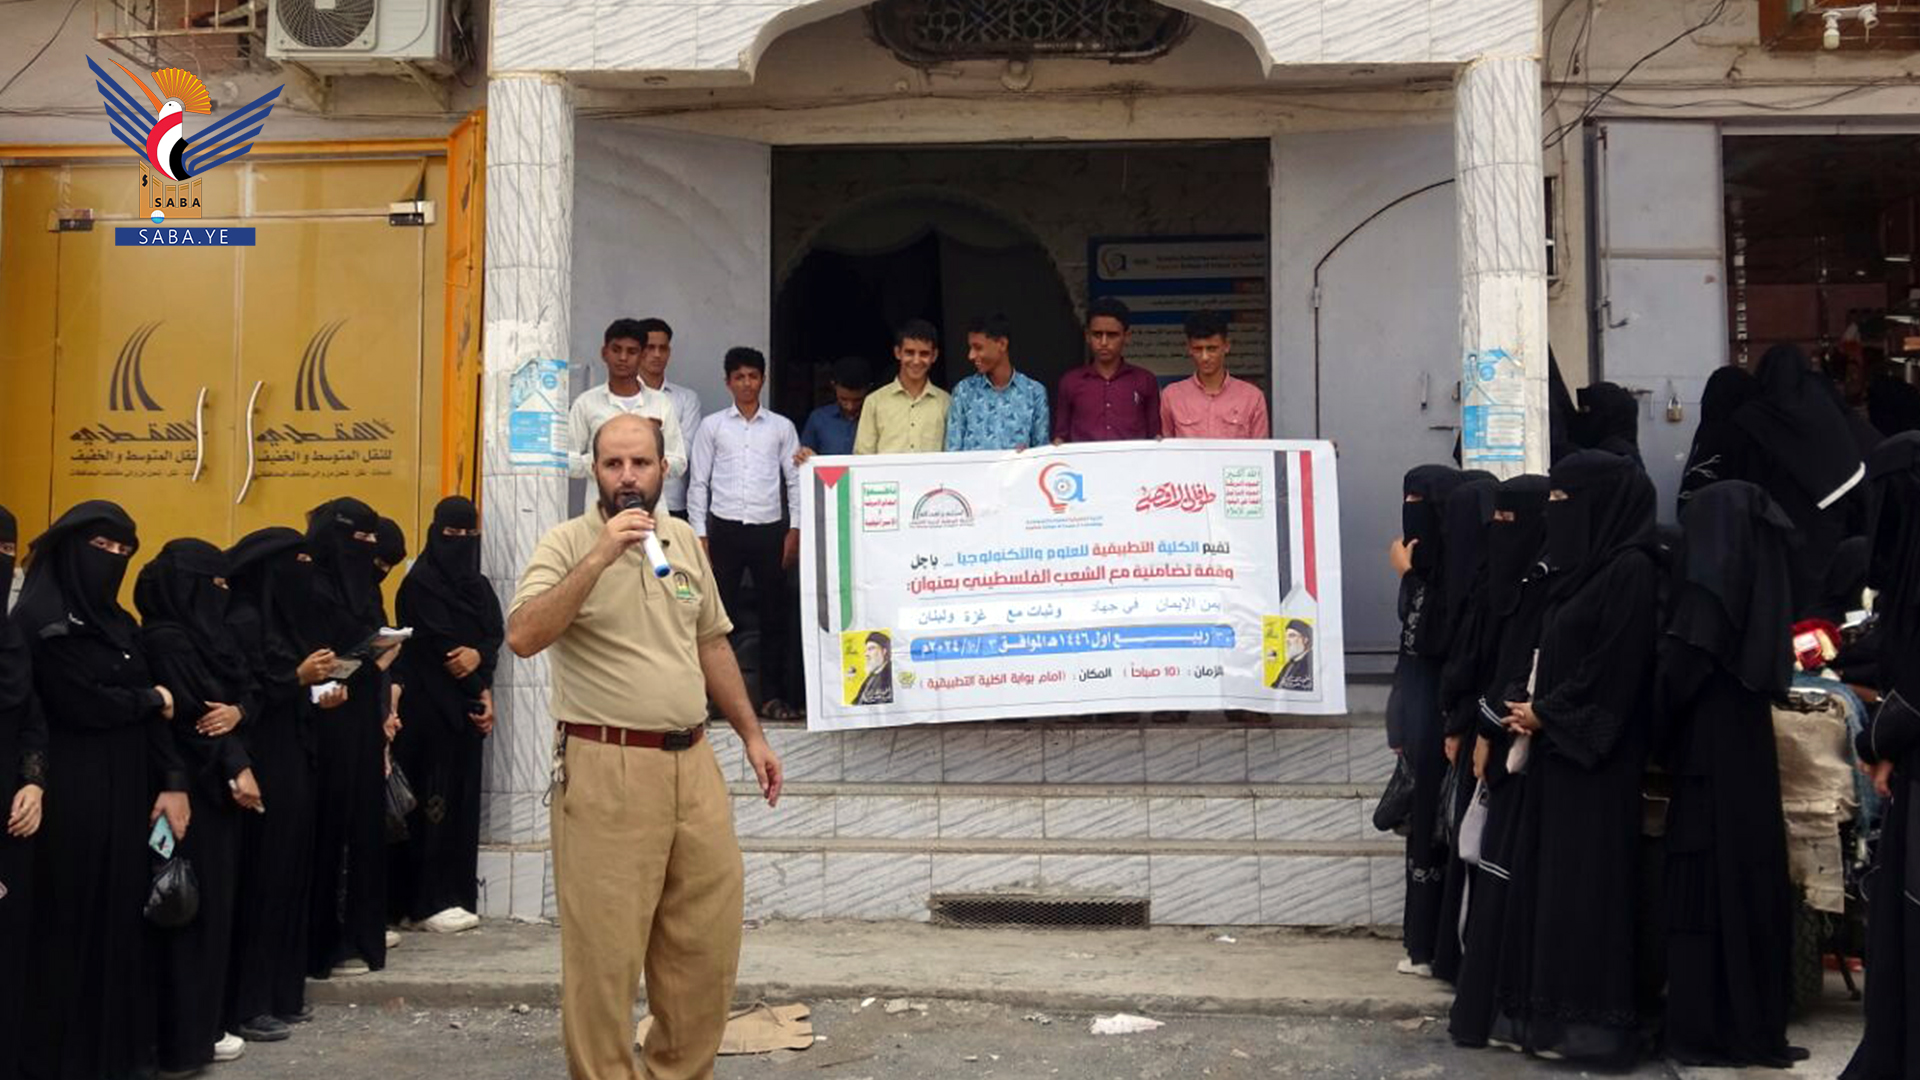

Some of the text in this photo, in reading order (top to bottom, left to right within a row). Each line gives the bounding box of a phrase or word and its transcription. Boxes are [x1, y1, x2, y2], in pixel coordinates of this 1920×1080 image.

[70, 449, 114, 464] الخفيف
[125, 449, 172, 464] المتوسط
[256, 449, 300, 464] الخفيف
[311, 449, 360, 464] المتوسط
[362, 449, 392, 463] للنقل
[1047, 544, 1089, 561] للعلوم
[1092, 541, 1155, 558] التطبيقية
[1157, 541, 1200, 556] الكلية
[1202, 541, 1231, 556] تقيم
[910, 553, 939, 570] باجل
[957, 547, 1044, 566] والتكنولوجيا
[906, 563, 1234, 595] وقفة تضامنية مع الشعب الفلسطيني بعنوان:
[1090, 599, 1118, 613] جهاد
[1122, 597, 1139, 614] في
[1200, 599, 1221, 613] يمن
[918, 608, 955, 625] ولبنان
[963, 608, 987, 625] غزة
[1006, 608, 1023, 623] مع
[926, 675, 975, 691] التطبيقية
[978, 673, 1007, 688] الكلية
[1010, 671, 1035, 686] بوابة
